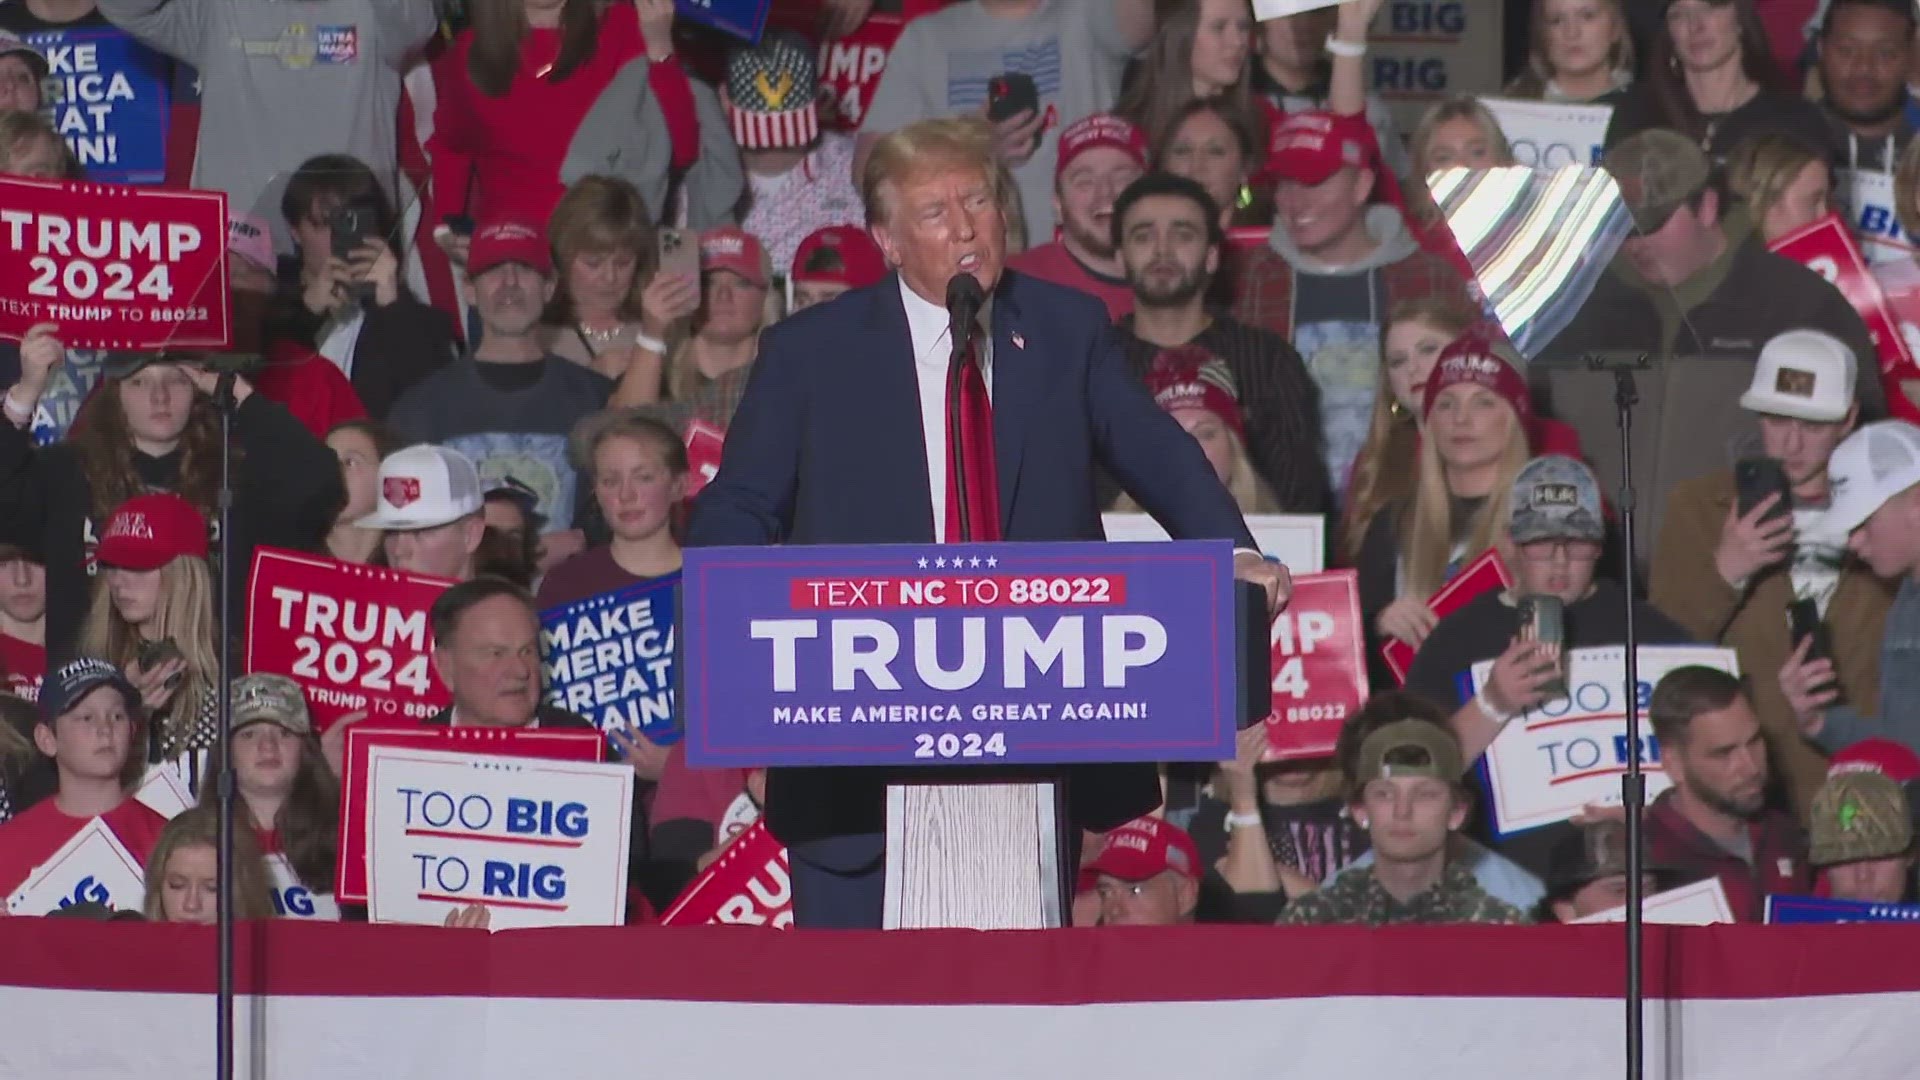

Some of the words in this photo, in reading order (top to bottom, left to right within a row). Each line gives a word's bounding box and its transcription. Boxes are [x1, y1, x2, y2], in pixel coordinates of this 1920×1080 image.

[1392, 3, 1465, 33] BIG
[1374, 57, 1447, 91] RIG
[1, 210, 201, 262] TRUMP
[28, 256, 173, 302] 2024
[0, 300, 40, 317] TEXT
[47, 304, 112, 321] TRUMP
[119, 308, 144, 321] TO
[150, 307, 208, 322] 88022
[1440, 353, 1501, 375] TRUMP
[1154, 383, 1206, 404] TRUMP
[807, 581, 889, 606] TEXT
[900, 580, 946, 604] NC
[955, 579, 1000, 604] TO
[1010, 578, 1110, 603] 88022
[272, 585, 436, 653] TRUM
[540, 599, 654, 656] MAKE
[292, 634, 431, 696] 2024
[750, 615, 1168, 692] TRUMP
[307, 686, 367, 710] TRUMP
[374, 698, 397, 714] TO
[404, 702, 446, 718] 880
[773, 706, 841, 724] MAKE
[850, 704, 962, 723] AMERICA
[971, 703, 1052, 721] GREAT
[1061, 702, 1147, 720] AGAIN!
[1287, 704, 1345, 722] 88022
[914, 732, 1007, 758] 2024
[1537, 738, 1610, 775] TO
[397, 788, 493, 830] TOO
[507, 797, 589, 838] BIG
[413, 854, 470, 893] TO
[483, 861, 567, 901] RIG
